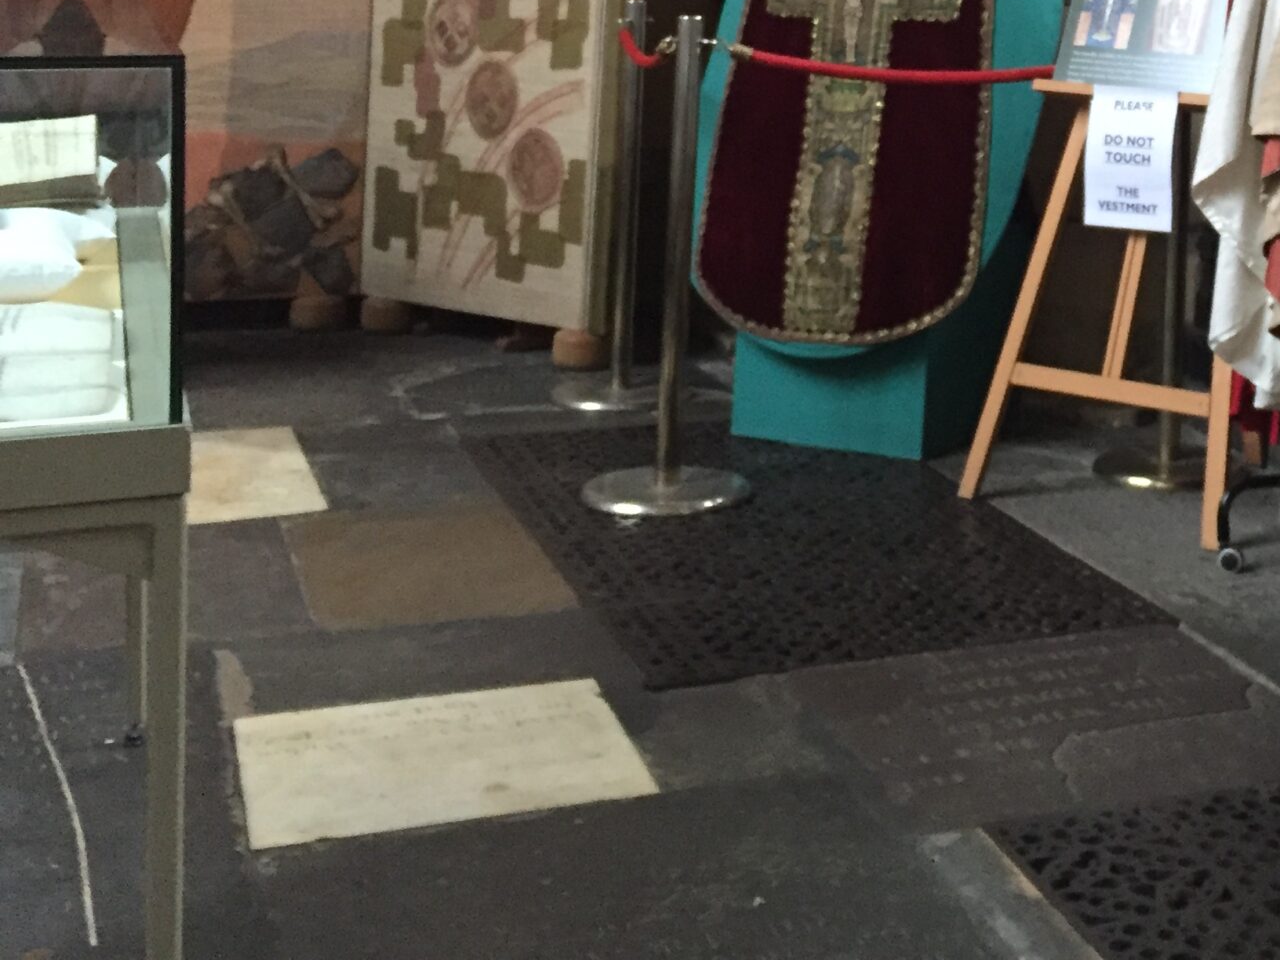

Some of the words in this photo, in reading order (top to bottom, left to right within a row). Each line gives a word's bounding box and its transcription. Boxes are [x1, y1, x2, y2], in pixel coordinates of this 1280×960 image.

[1114, 100, 1154, 111] PLEASE
[1104, 134, 1123, 146] DO
[1126, 136, 1154, 148] NOT
[1105, 151, 1151, 164] TOUCH
[1116, 186, 1140, 198] THE
[1098, 200, 1159, 214] VESTMENT
